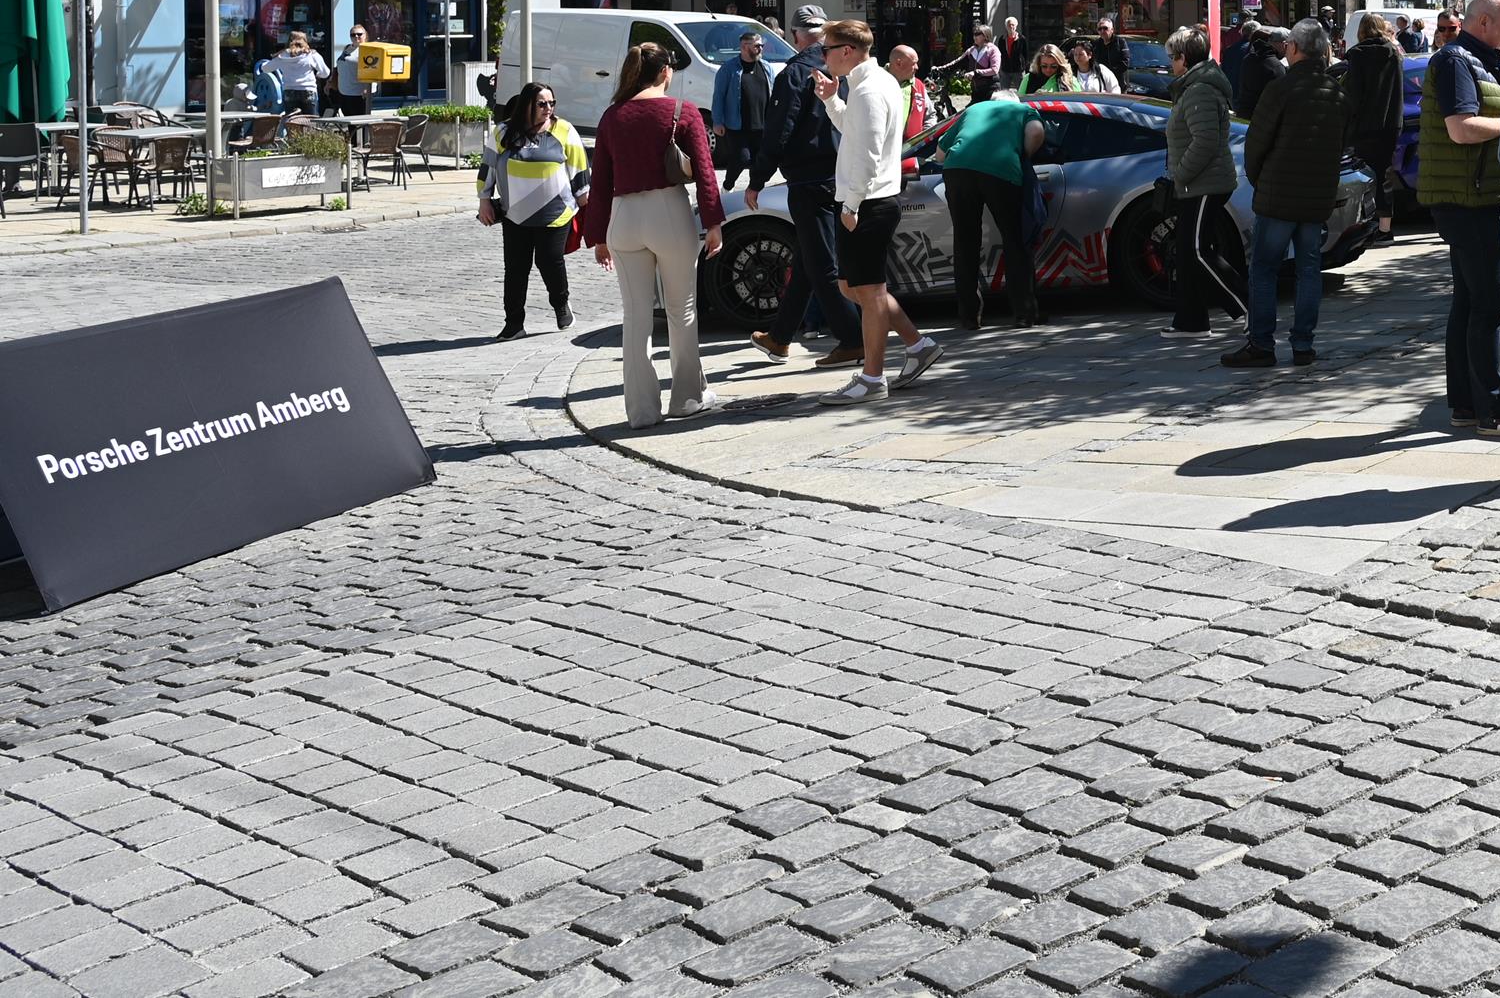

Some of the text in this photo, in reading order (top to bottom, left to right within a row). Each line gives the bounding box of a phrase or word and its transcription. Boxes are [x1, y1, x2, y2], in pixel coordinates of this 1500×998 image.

[755, 0, 778, 8] STREB
[37, 385, 351, 485] Porsche Zentrum Amberg
